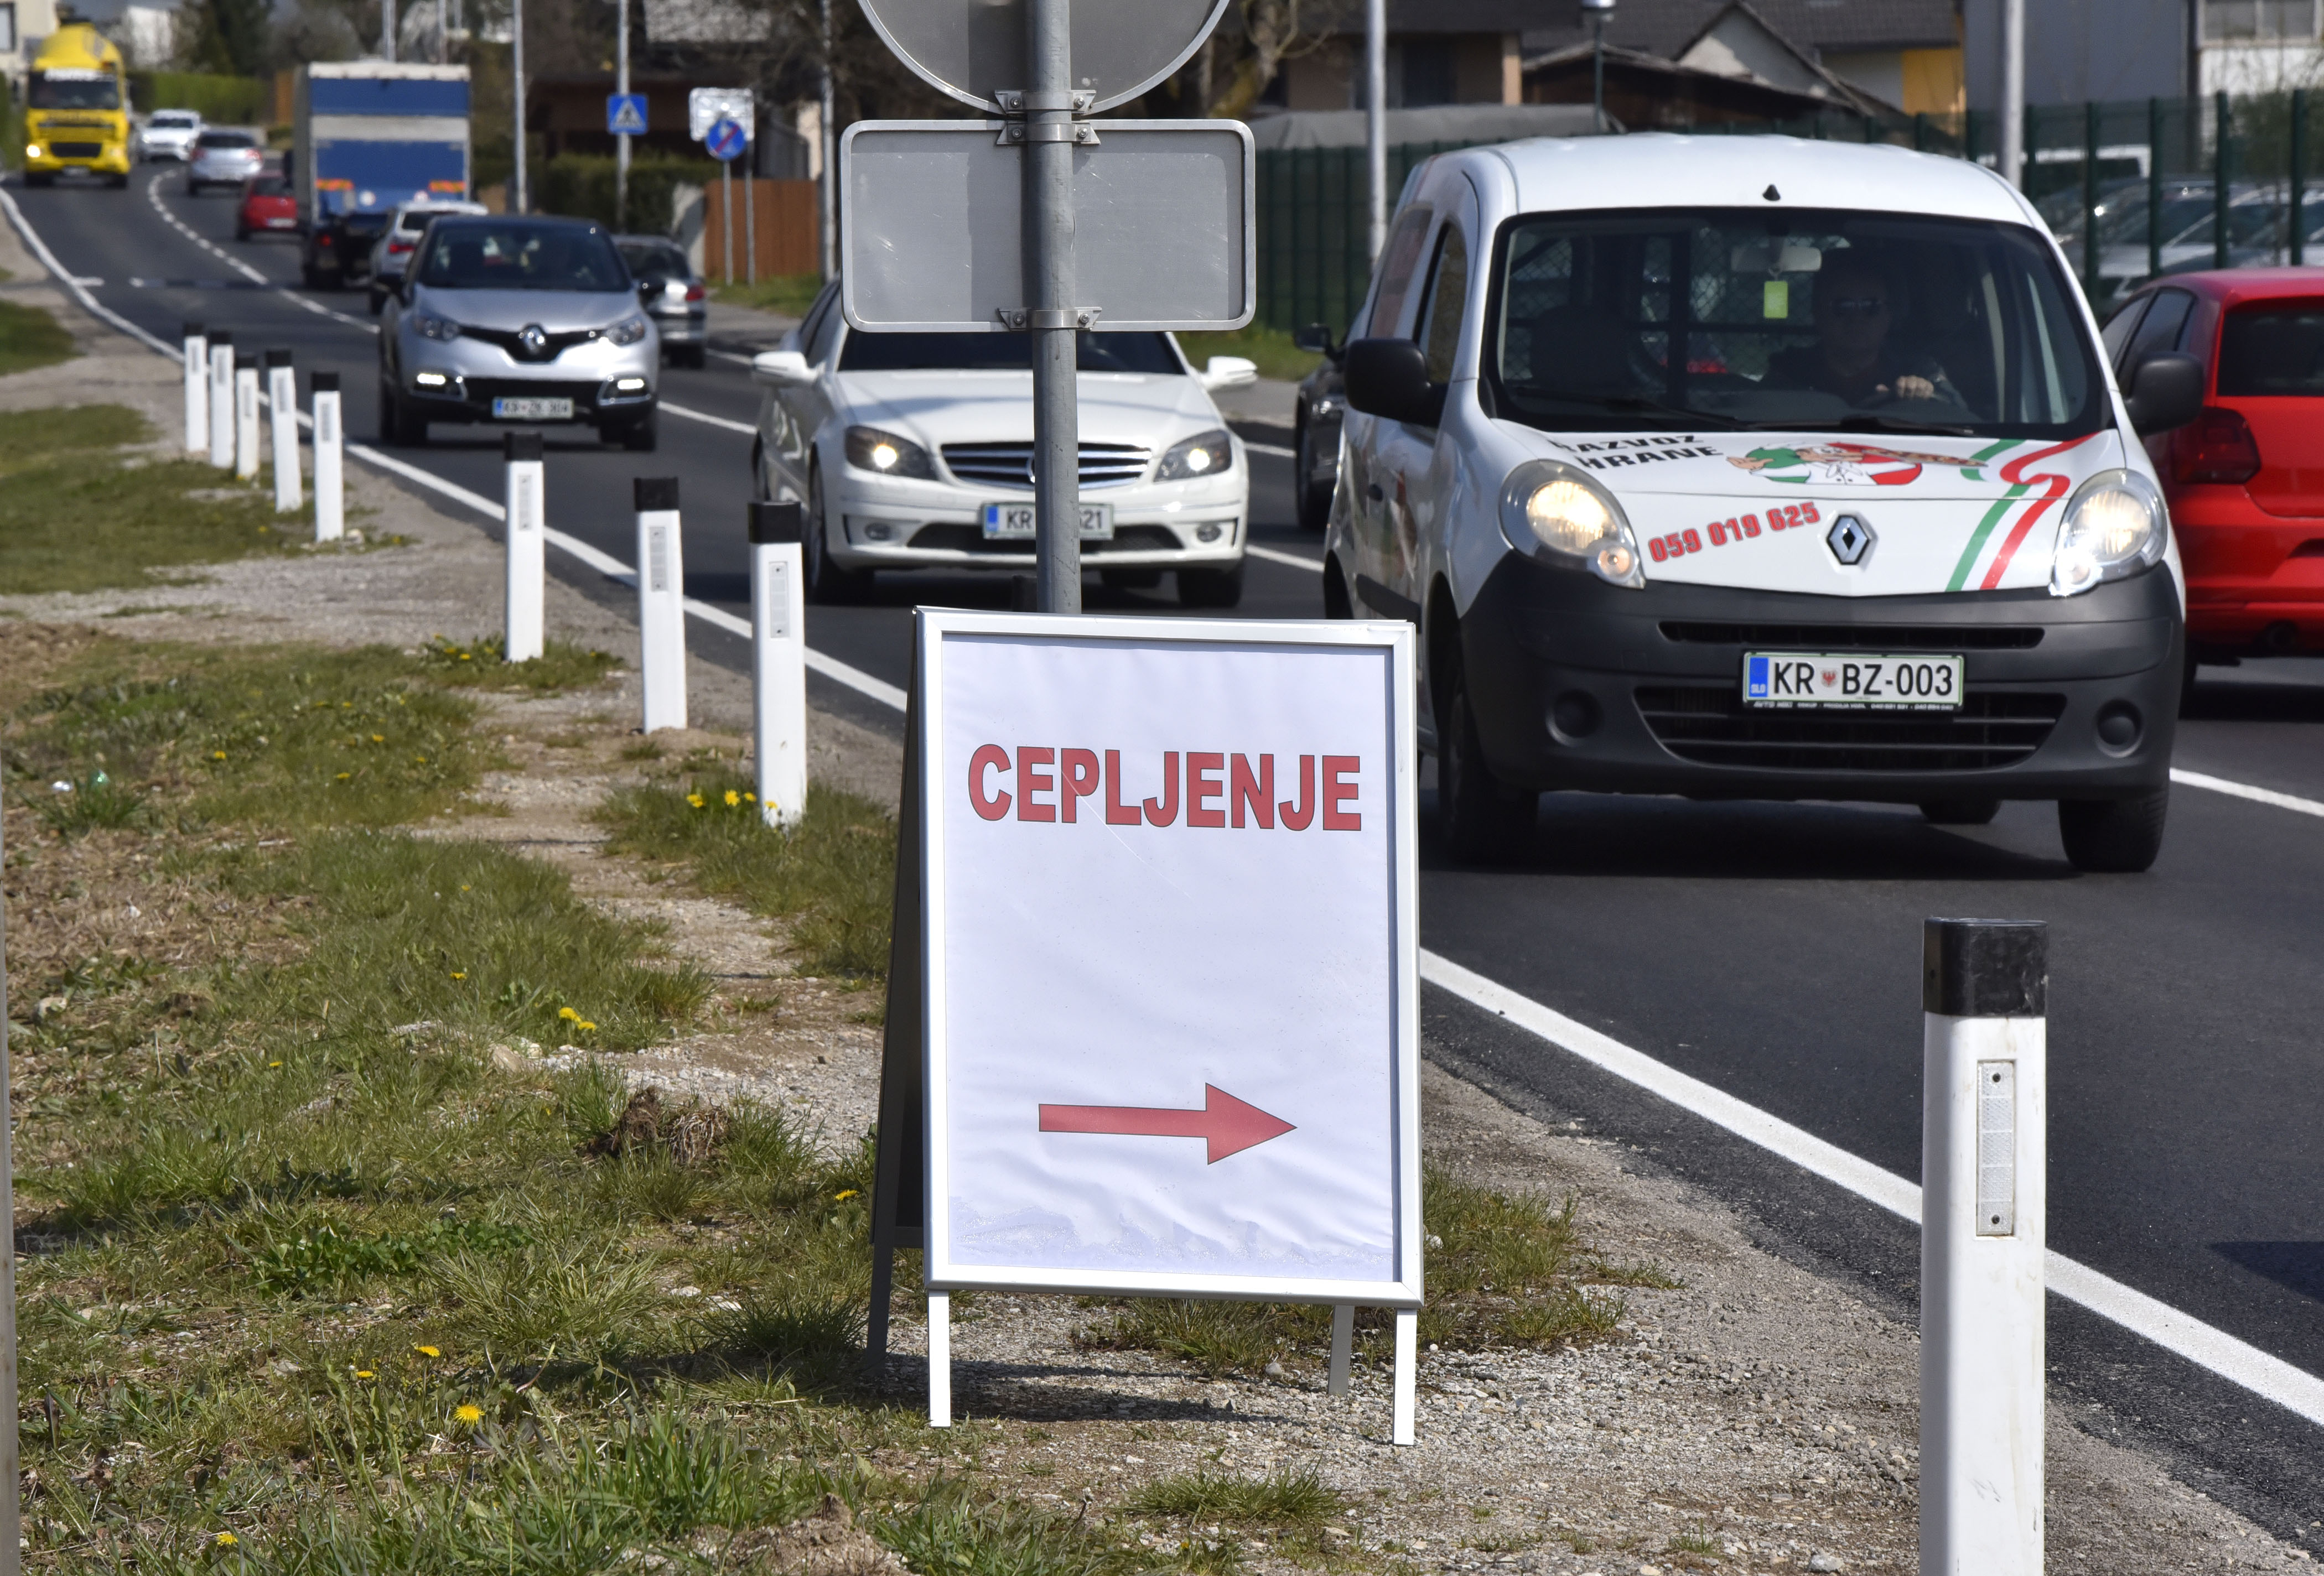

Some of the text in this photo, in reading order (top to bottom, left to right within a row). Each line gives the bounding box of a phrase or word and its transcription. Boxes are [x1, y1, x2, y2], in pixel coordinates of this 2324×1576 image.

[1547, 435, 1704, 452] RAZVOZ
[1574, 446, 1723, 469] HRANE
[1007, 509, 1103, 529] KR 21
[1648, 501, 1820, 562] 059 019 625
[1774, 662, 1953, 696] KR BZ-003
[967, 743, 1362, 831] CEPLJENJE
